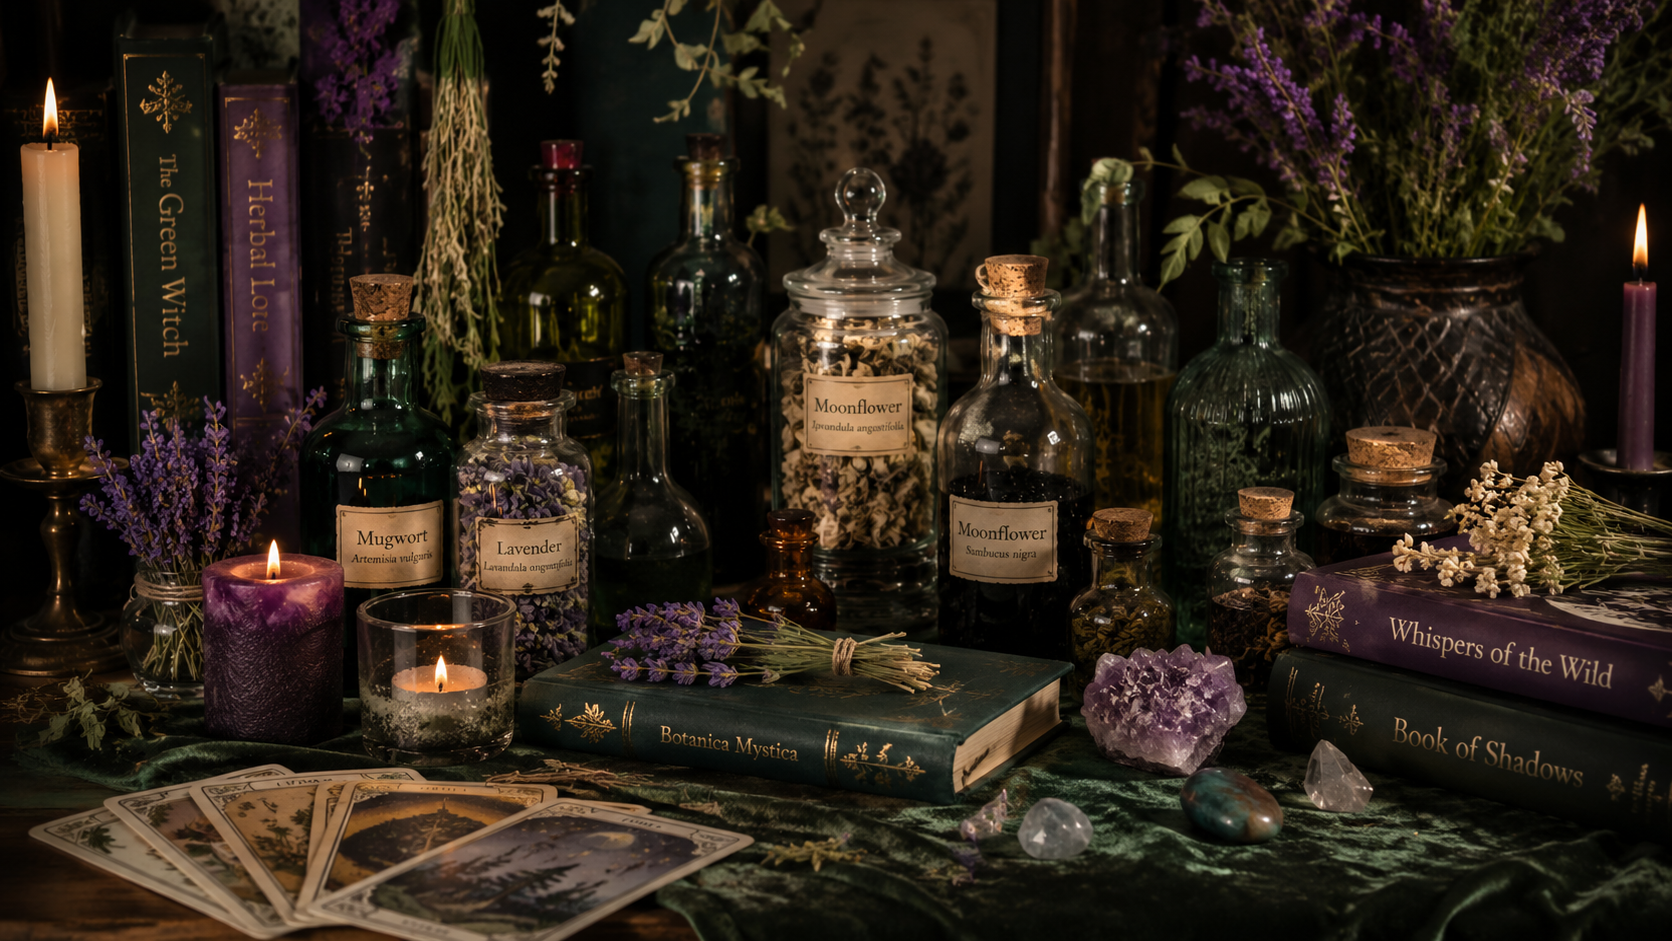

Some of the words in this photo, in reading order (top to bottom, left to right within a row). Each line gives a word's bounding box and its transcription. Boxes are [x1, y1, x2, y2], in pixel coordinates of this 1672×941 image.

[159, 153, 179, 188] The
[158, 193, 184, 271] Green
[247, 178, 276, 269] Herbal
[161, 276, 189, 358] Witch
[250, 277, 276, 333] Lore
[814, 396, 903, 415] Moonflower
[356, 529, 428, 550] Mugwort
[496, 539, 562, 556] Lavender
[957, 520, 1047, 541] Moonflower
[965, 545, 1010, 559] Sambucus
[1012, 548, 1037, 562] nigra
[1389, 616, 1484, 660] Whispers
[1490, 641, 1517, 667] of
[1518, 647, 1553, 675] the
[1559, 654, 1614, 690] Wild
[660, 725, 730, 752] Botanica
[734, 736, 799, 762] Mystica
[1392, 716, 1449, 755] Book
[1455, 735, 1482, 762] of
[1484, 740, 1584, 788] Shadows
